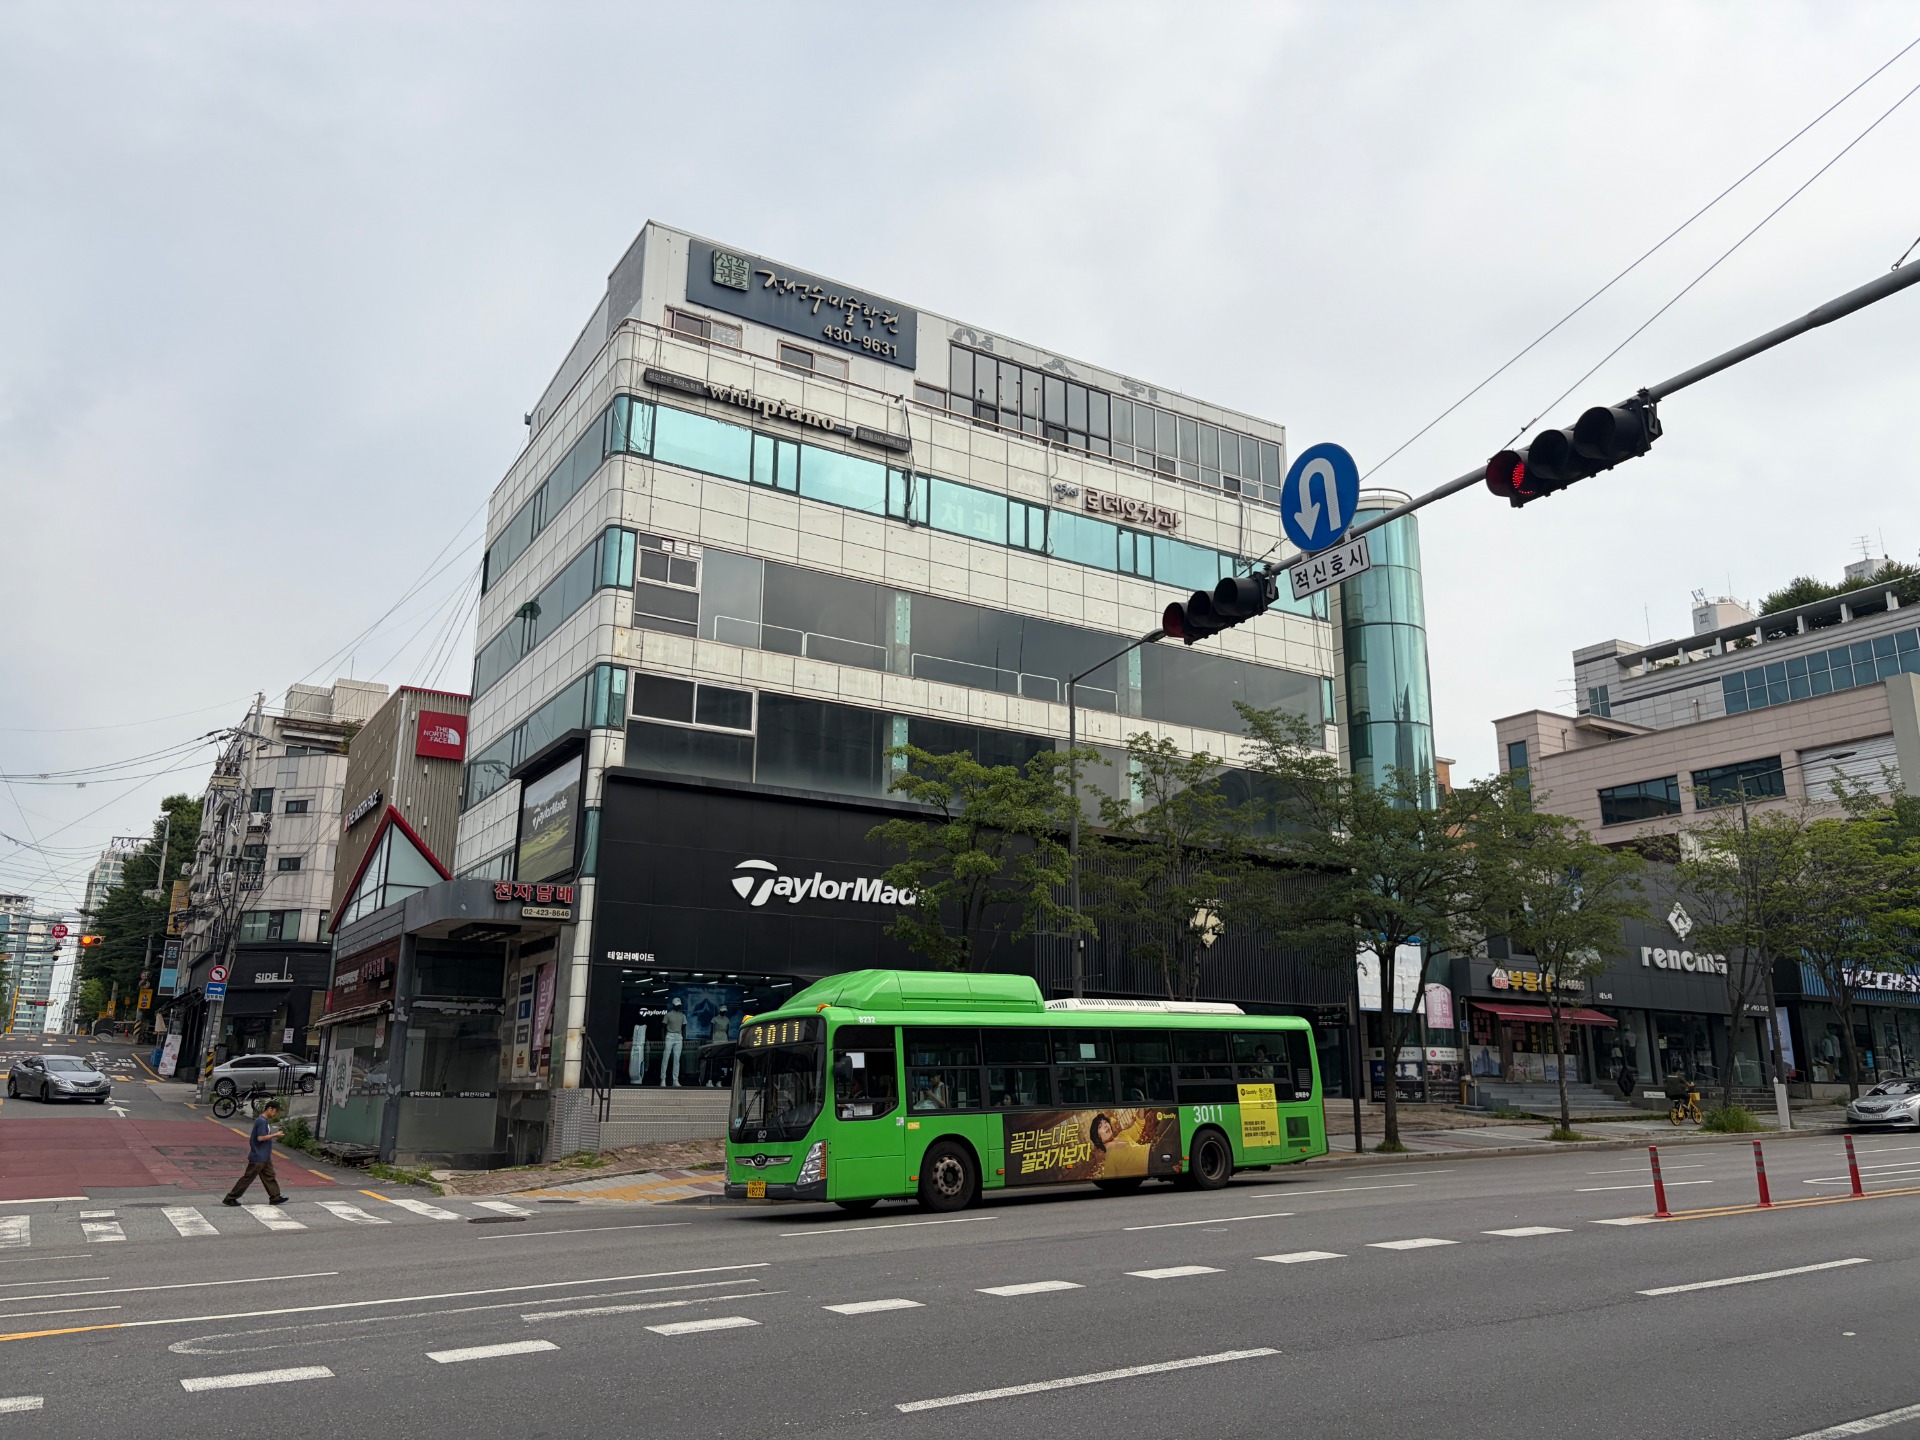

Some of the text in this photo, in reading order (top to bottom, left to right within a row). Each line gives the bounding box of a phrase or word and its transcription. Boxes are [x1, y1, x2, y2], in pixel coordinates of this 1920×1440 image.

[755, 269, 900, 334] 정성수미술학원
[824, 324, 898, 358] 430-9631
[673, 378, 702, 391] 피아노학원
[708, 383, 836, 431] withpiano
[1086, 487, 1182, 529] 로데오치과
[1295, 544, 1364, 589] 적신호시
[423, 730, 449, 738] NORTH
[435, 725, 449, 733] THE
[532, 796, 568, 831] TaylorMade
[494, 881, 574, 904] 전자담배
[731, 859, 926, 907] TaylorMad
[523, 907, 570, 918] 02-423-8646
[607, 950, 655, 963] 테일러메이드
[255, 972, 278, 981] SIDE
[858, 1015, 876, 1024] 8232
[752, 1020, 801, 1048] 3011
[1163, 1112, 1176, 1120] Spotify
[1193, 1104, 1223, 1123] 3011
[1010, 1123, 1079, 1154] 끌리는대로
[1020, 1142, 1092, 1175] 끌려가보자
